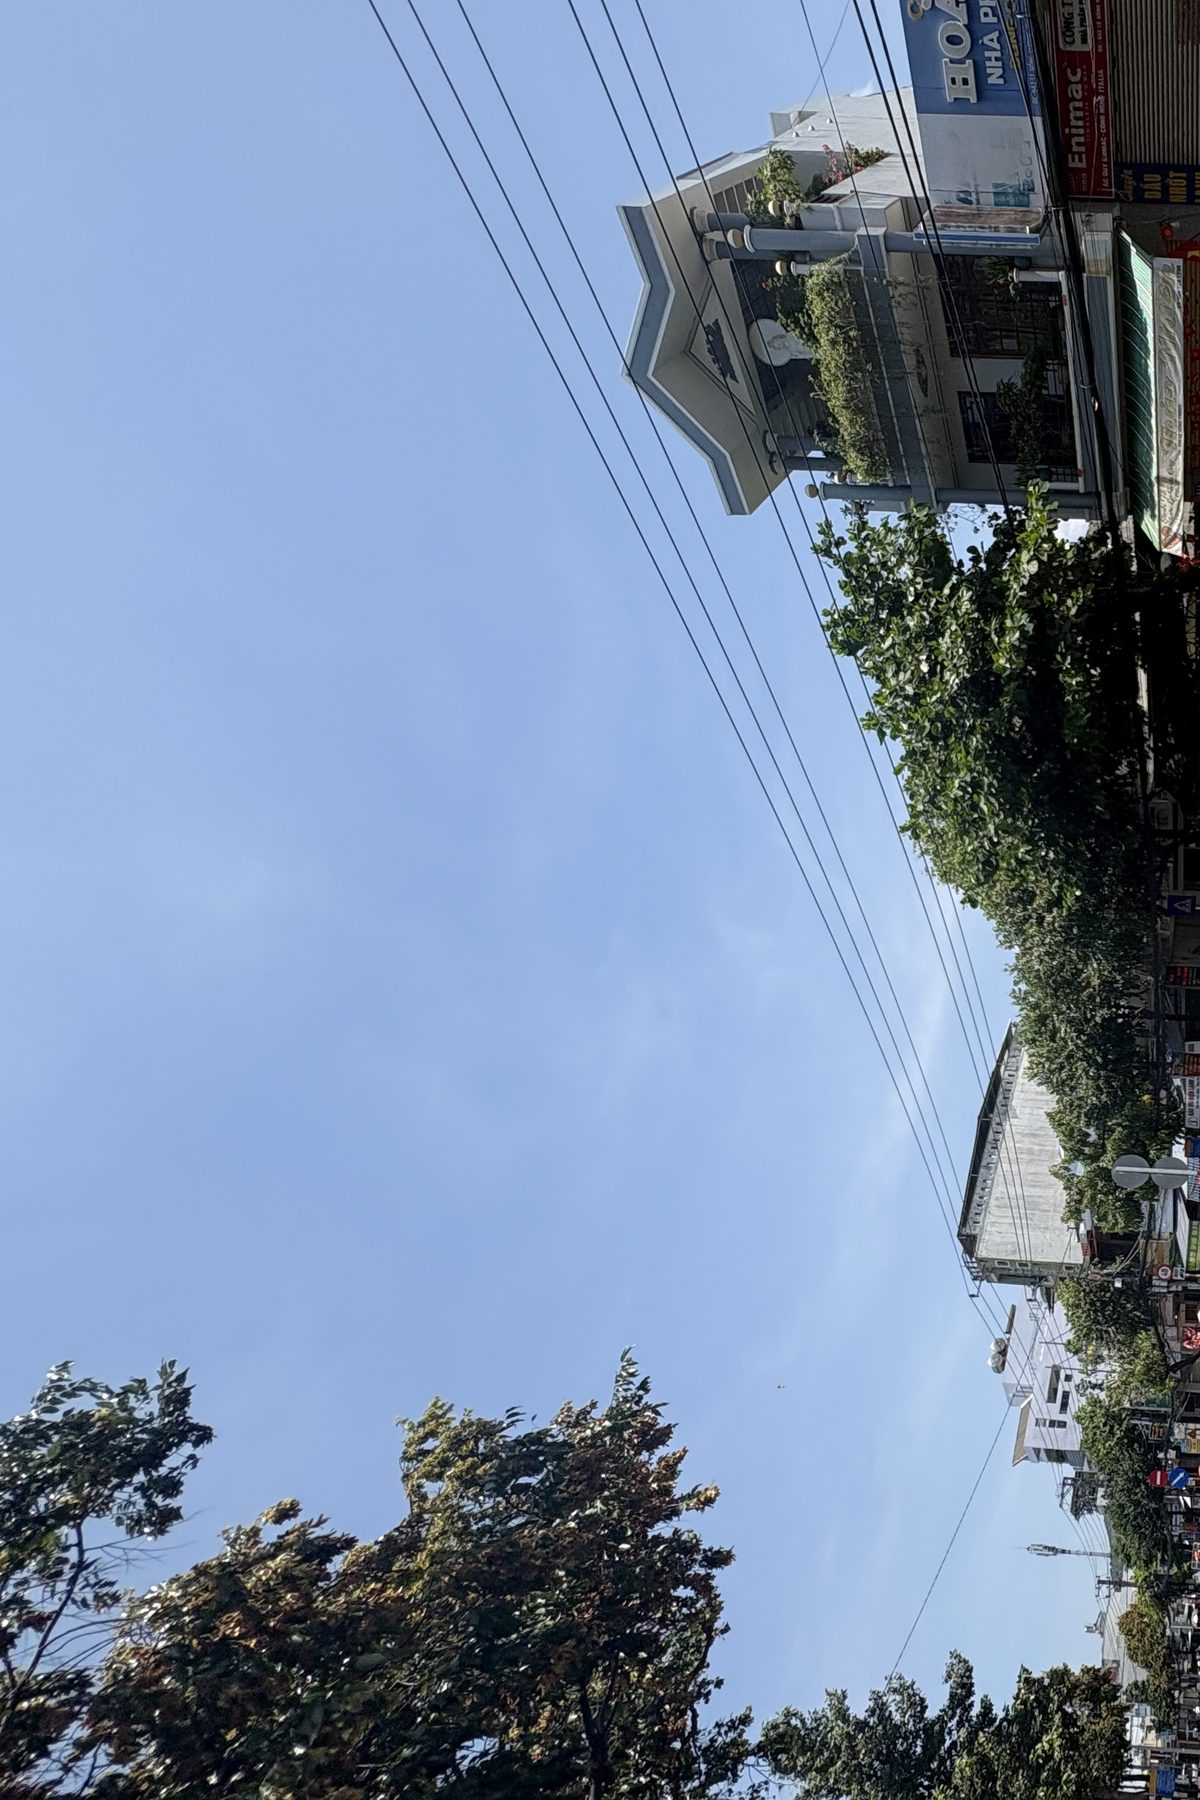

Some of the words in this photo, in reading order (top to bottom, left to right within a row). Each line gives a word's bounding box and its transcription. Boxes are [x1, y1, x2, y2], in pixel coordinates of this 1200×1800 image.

[1061, 12, 1075, 45] CÔNG
[979, 30, 1005, 85] NHÀ
[1097, 68, 1105, 93] ITALIA
[1064, 67, 1088, 169] Enimac
[1165, 171, 1188, 203] NHỚT
